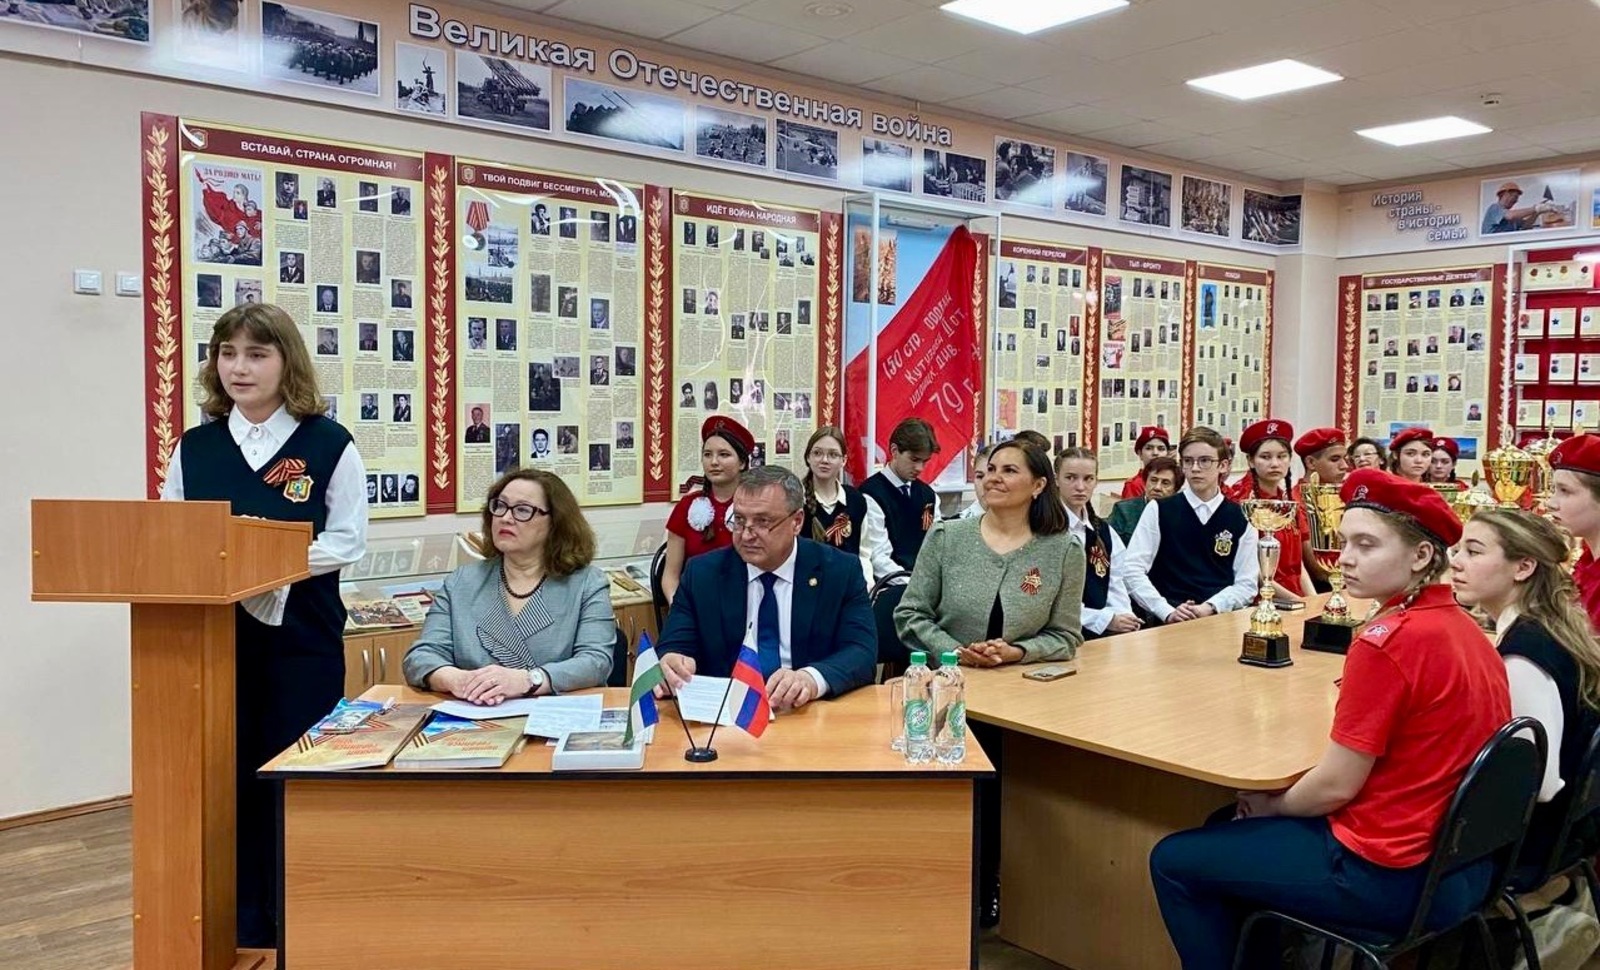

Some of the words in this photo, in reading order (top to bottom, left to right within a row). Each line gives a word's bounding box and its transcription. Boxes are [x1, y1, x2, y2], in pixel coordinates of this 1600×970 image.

[409, 3, 596, 72] Великая
[608, 49, 863, 128] Отечественная
[872, 113, 953, 146] война
[241, 141, 294, 158] ВСТАВАЙ,
[295, 149, 336, 163] СТРАНА
[482, 173, 506, 184] ТВОЙ
[507, 177, 541, 189] ПОДВИГ
[543, 182, 598, 197] БЕССМЕРТЕН,
[1372, 190, 1422, 206] История
[728, 207, 755, 219] ВОЙНА
[756, 211, 797, 224] НАРОДНАЯ
[1389, 204, 1433, 219] страны
[1398, 219, 1406, 230] в
[1409, 214, 1460, 228] истории
[1428, 228, 1467, 241] семьи
[882, 349, 903, 380] 150
[928, 382, 964, 423] 79
